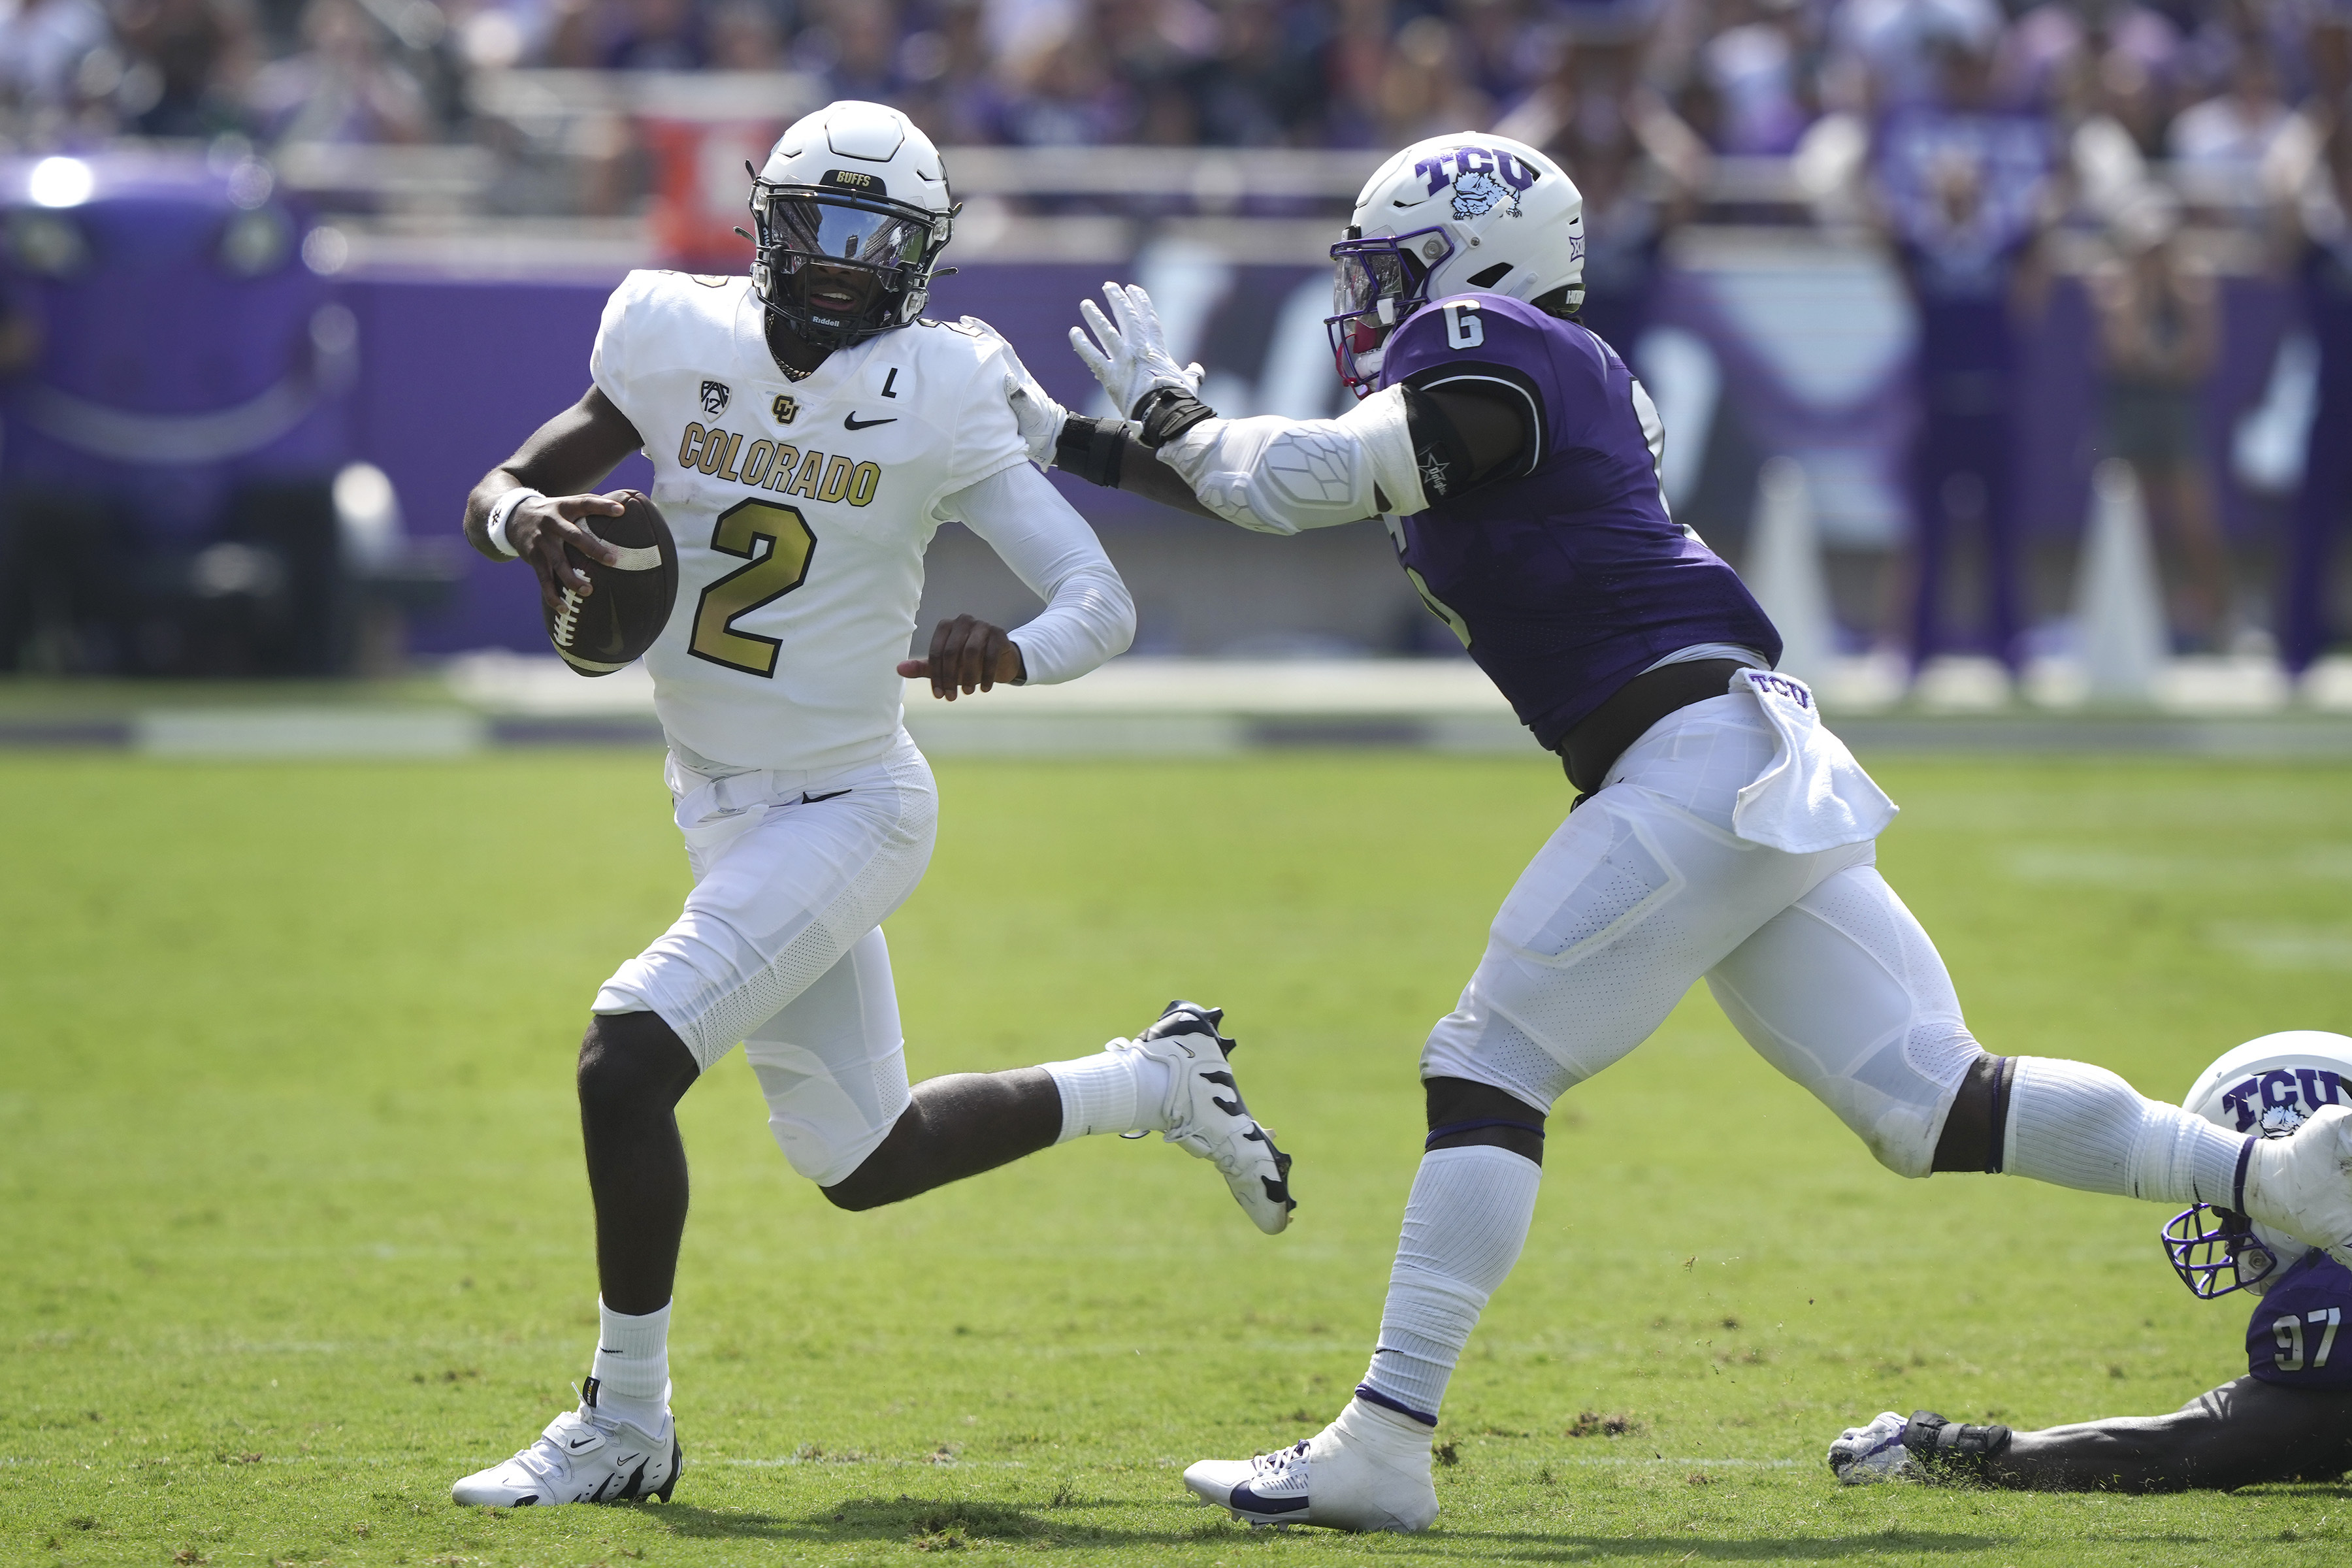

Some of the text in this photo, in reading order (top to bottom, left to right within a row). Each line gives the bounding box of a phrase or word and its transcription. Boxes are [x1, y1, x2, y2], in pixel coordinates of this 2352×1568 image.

[836, 171, 872, 188] BUFFS
[1414, 147, 1533, 197] TCU
[812, 316, 840, 327] Riddell
[1441, 299, 1485, 350] 6
[701, 381, 730, 408] PAC
[881, 367, 898, 399] L
[704, 397, 721, 414] 12
[772, 393, 801, 425] CU
[678, 421, 881, 507] COLORADO
[687, 497, 817, 679] 2
[1748, 674, 1808, 710] TCU
[2223, 1068, 2342, 1134] TCU
[2272, 1306, 2341, 1371] 97
